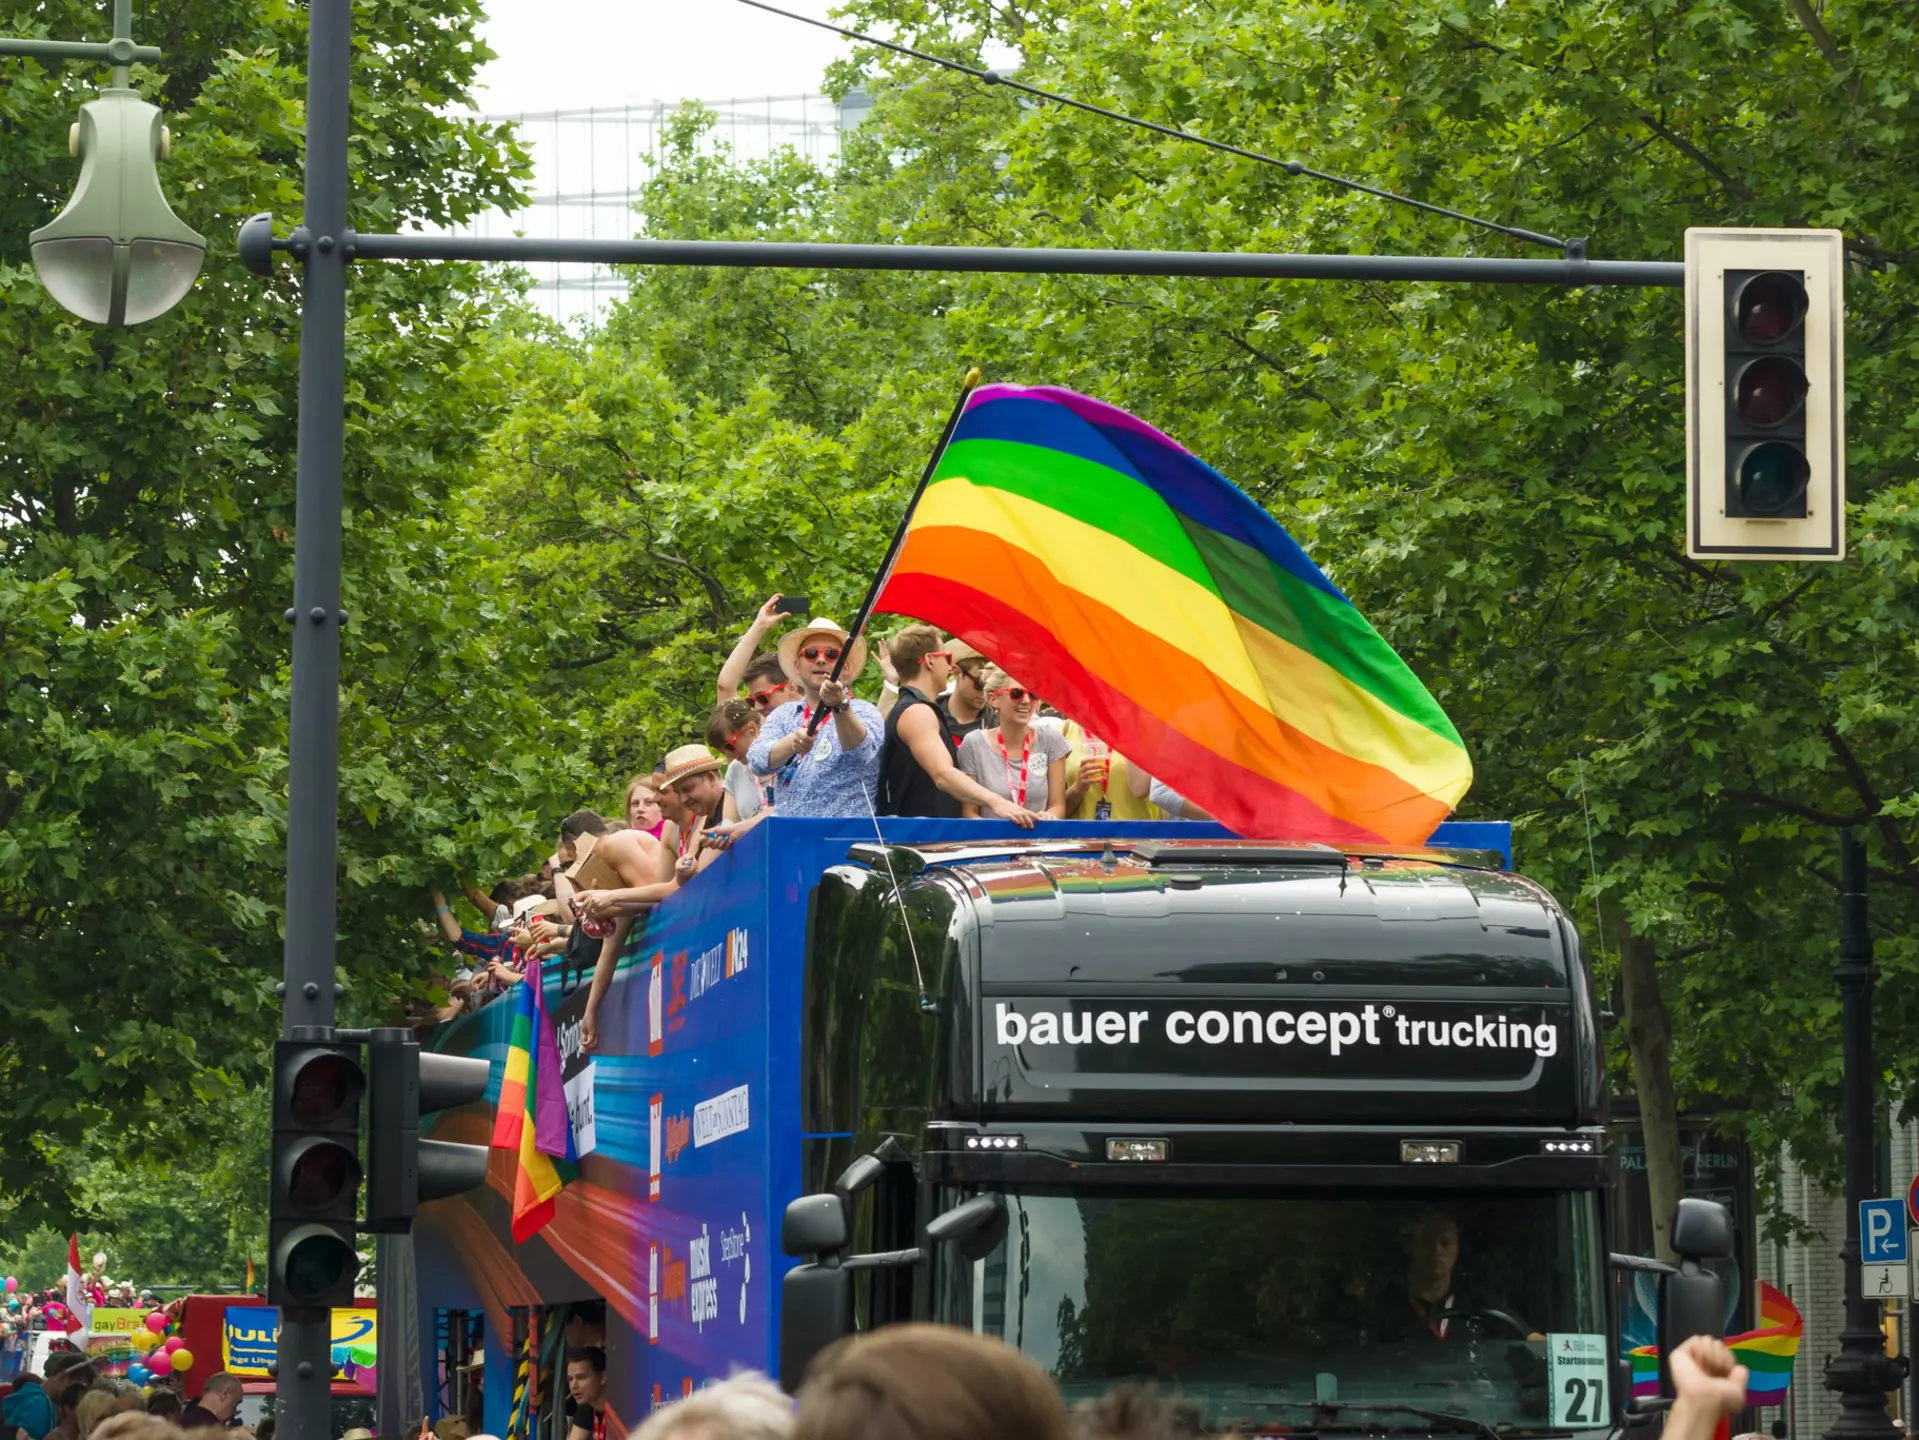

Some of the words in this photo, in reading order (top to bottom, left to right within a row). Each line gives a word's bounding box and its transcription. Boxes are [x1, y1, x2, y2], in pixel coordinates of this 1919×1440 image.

[731, 926, 748, 976] N24
[996, 1004, 1148, 1045] bauer
[1396, 1013, 1557, 1057] trucking
[1620, 1155, 1647, 1170] PAL
[1697, 1153, 1738, 1169] BERLIN
[1867, 1208, 1892, 1254] P
[1564, 1377, 1603, 1423] 27
